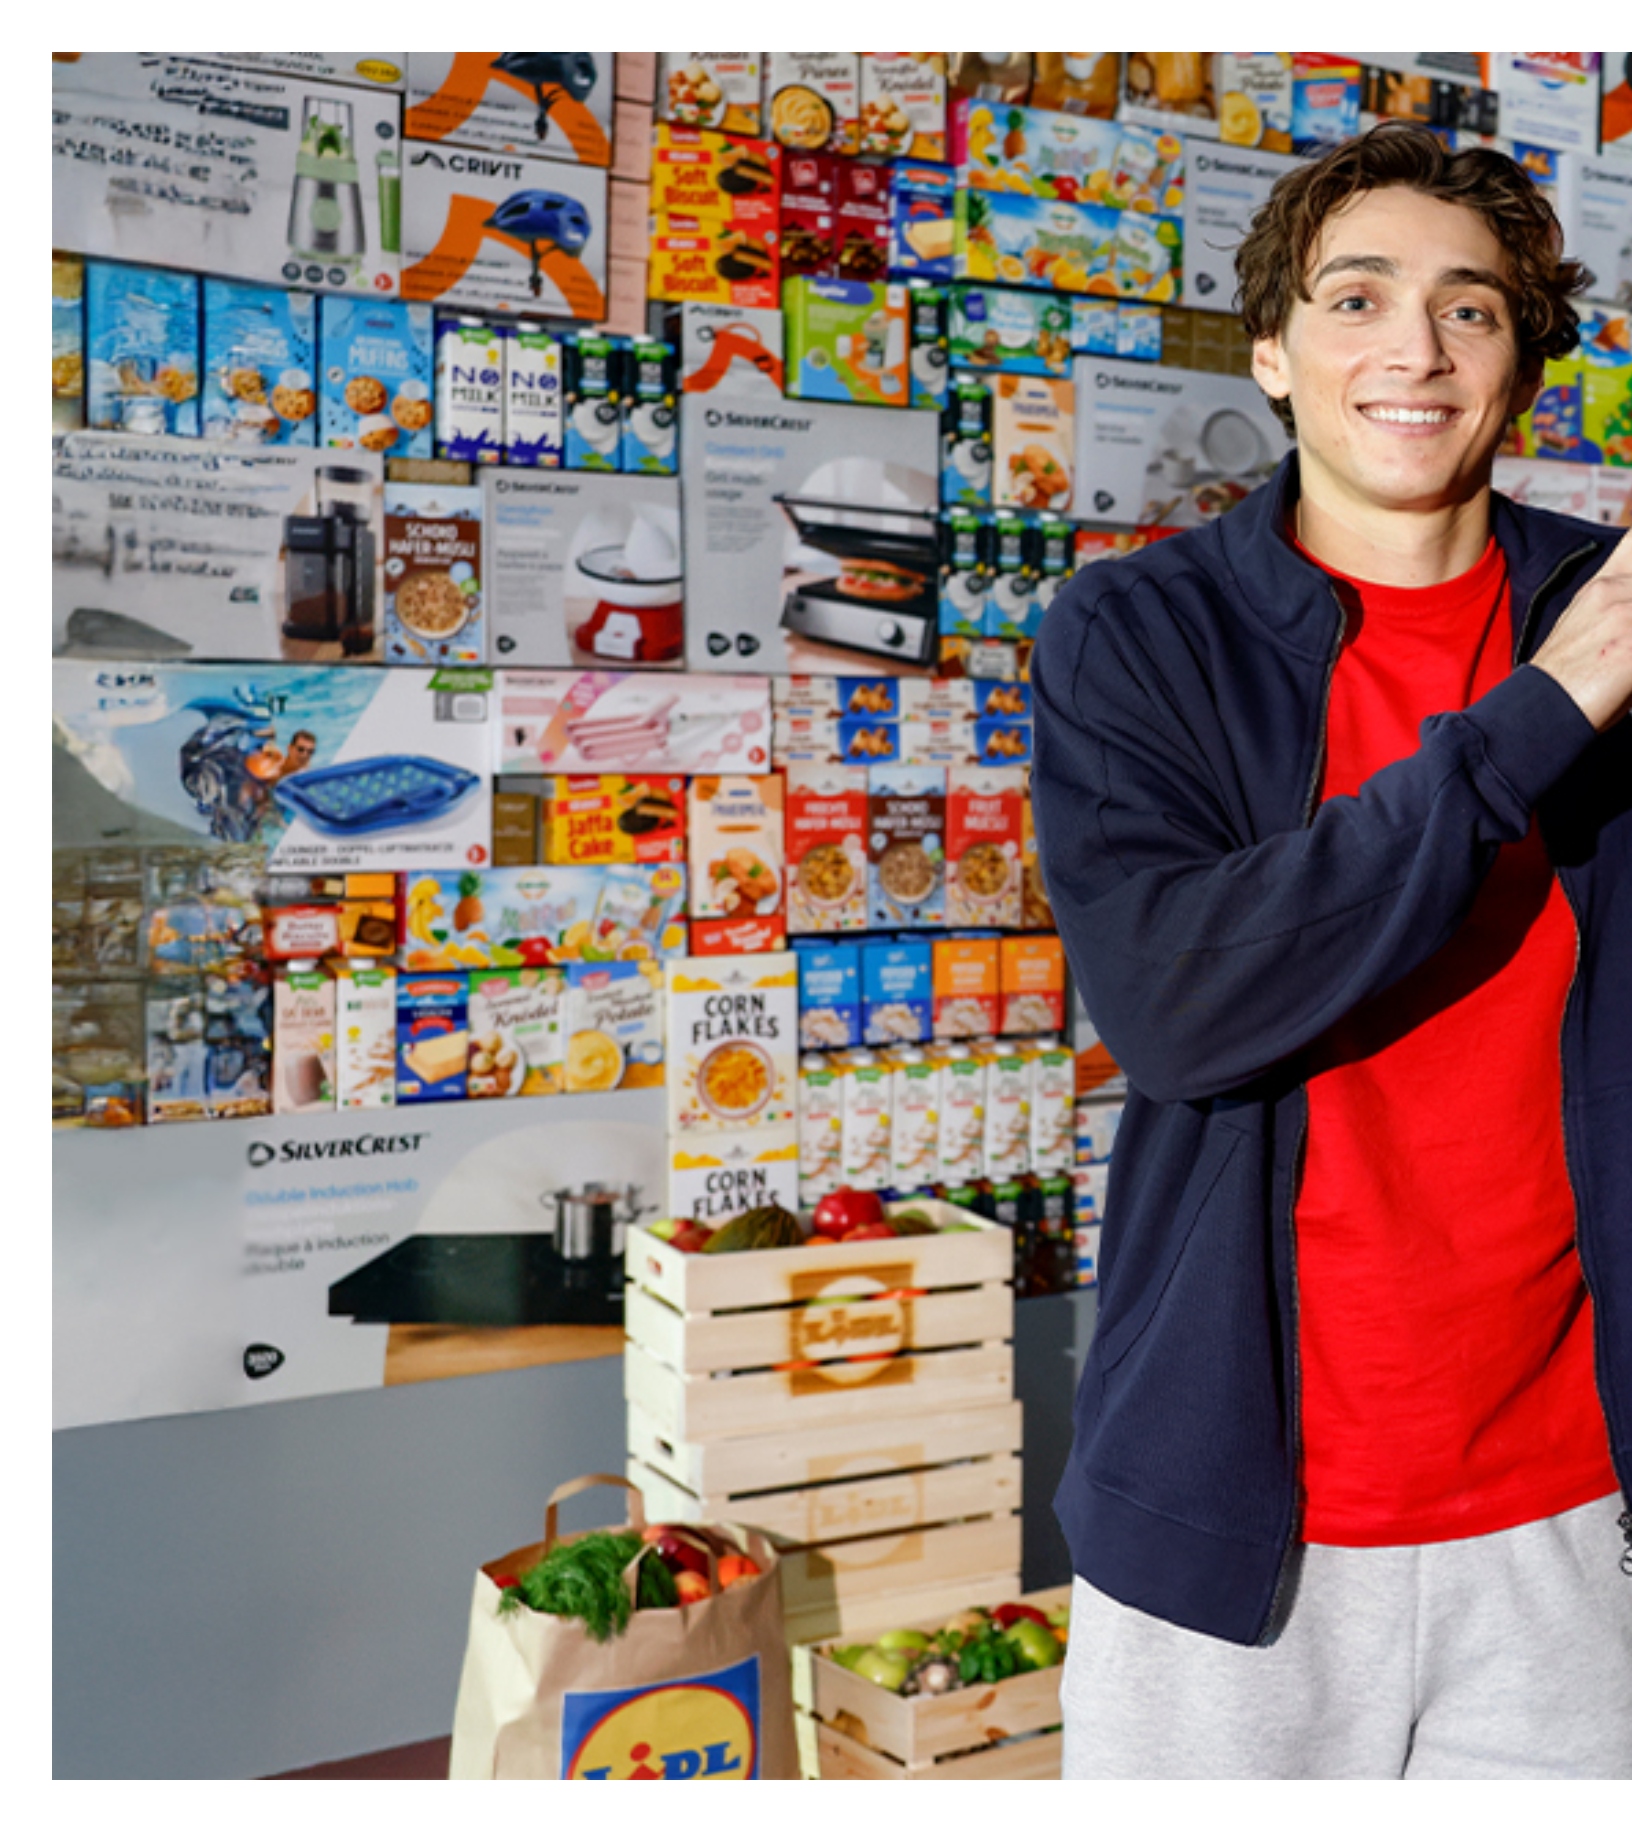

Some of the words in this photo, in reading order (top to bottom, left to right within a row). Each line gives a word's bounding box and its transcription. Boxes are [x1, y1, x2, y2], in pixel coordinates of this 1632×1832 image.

[449, 154, 524, 180] CRIVIT
[672, 166, 708, 187] Soft
[671, 253, 708, 274] Soft
[451, 386, 499, 403] MILK
[511, 390, 557, 408] MILK
[405, 522, 457, 539] SCHOKO
[569, 815, 613, 837] Jaffa
[569, 837, 614, 860] Cake
[704, 992, 766, 1019] CORN
[692, 1016, 780, 1045] FLAKES
[309, 1182, 383, 1199] Induction
[385, 1178, 419, 1194] Hob
[706, 1167, 767, 1195] CORN
[692, 1189, 780, 1219] FLAKES
[316, 1231, 390, 1251] induction
[244, 1258, 305, 1276] double
